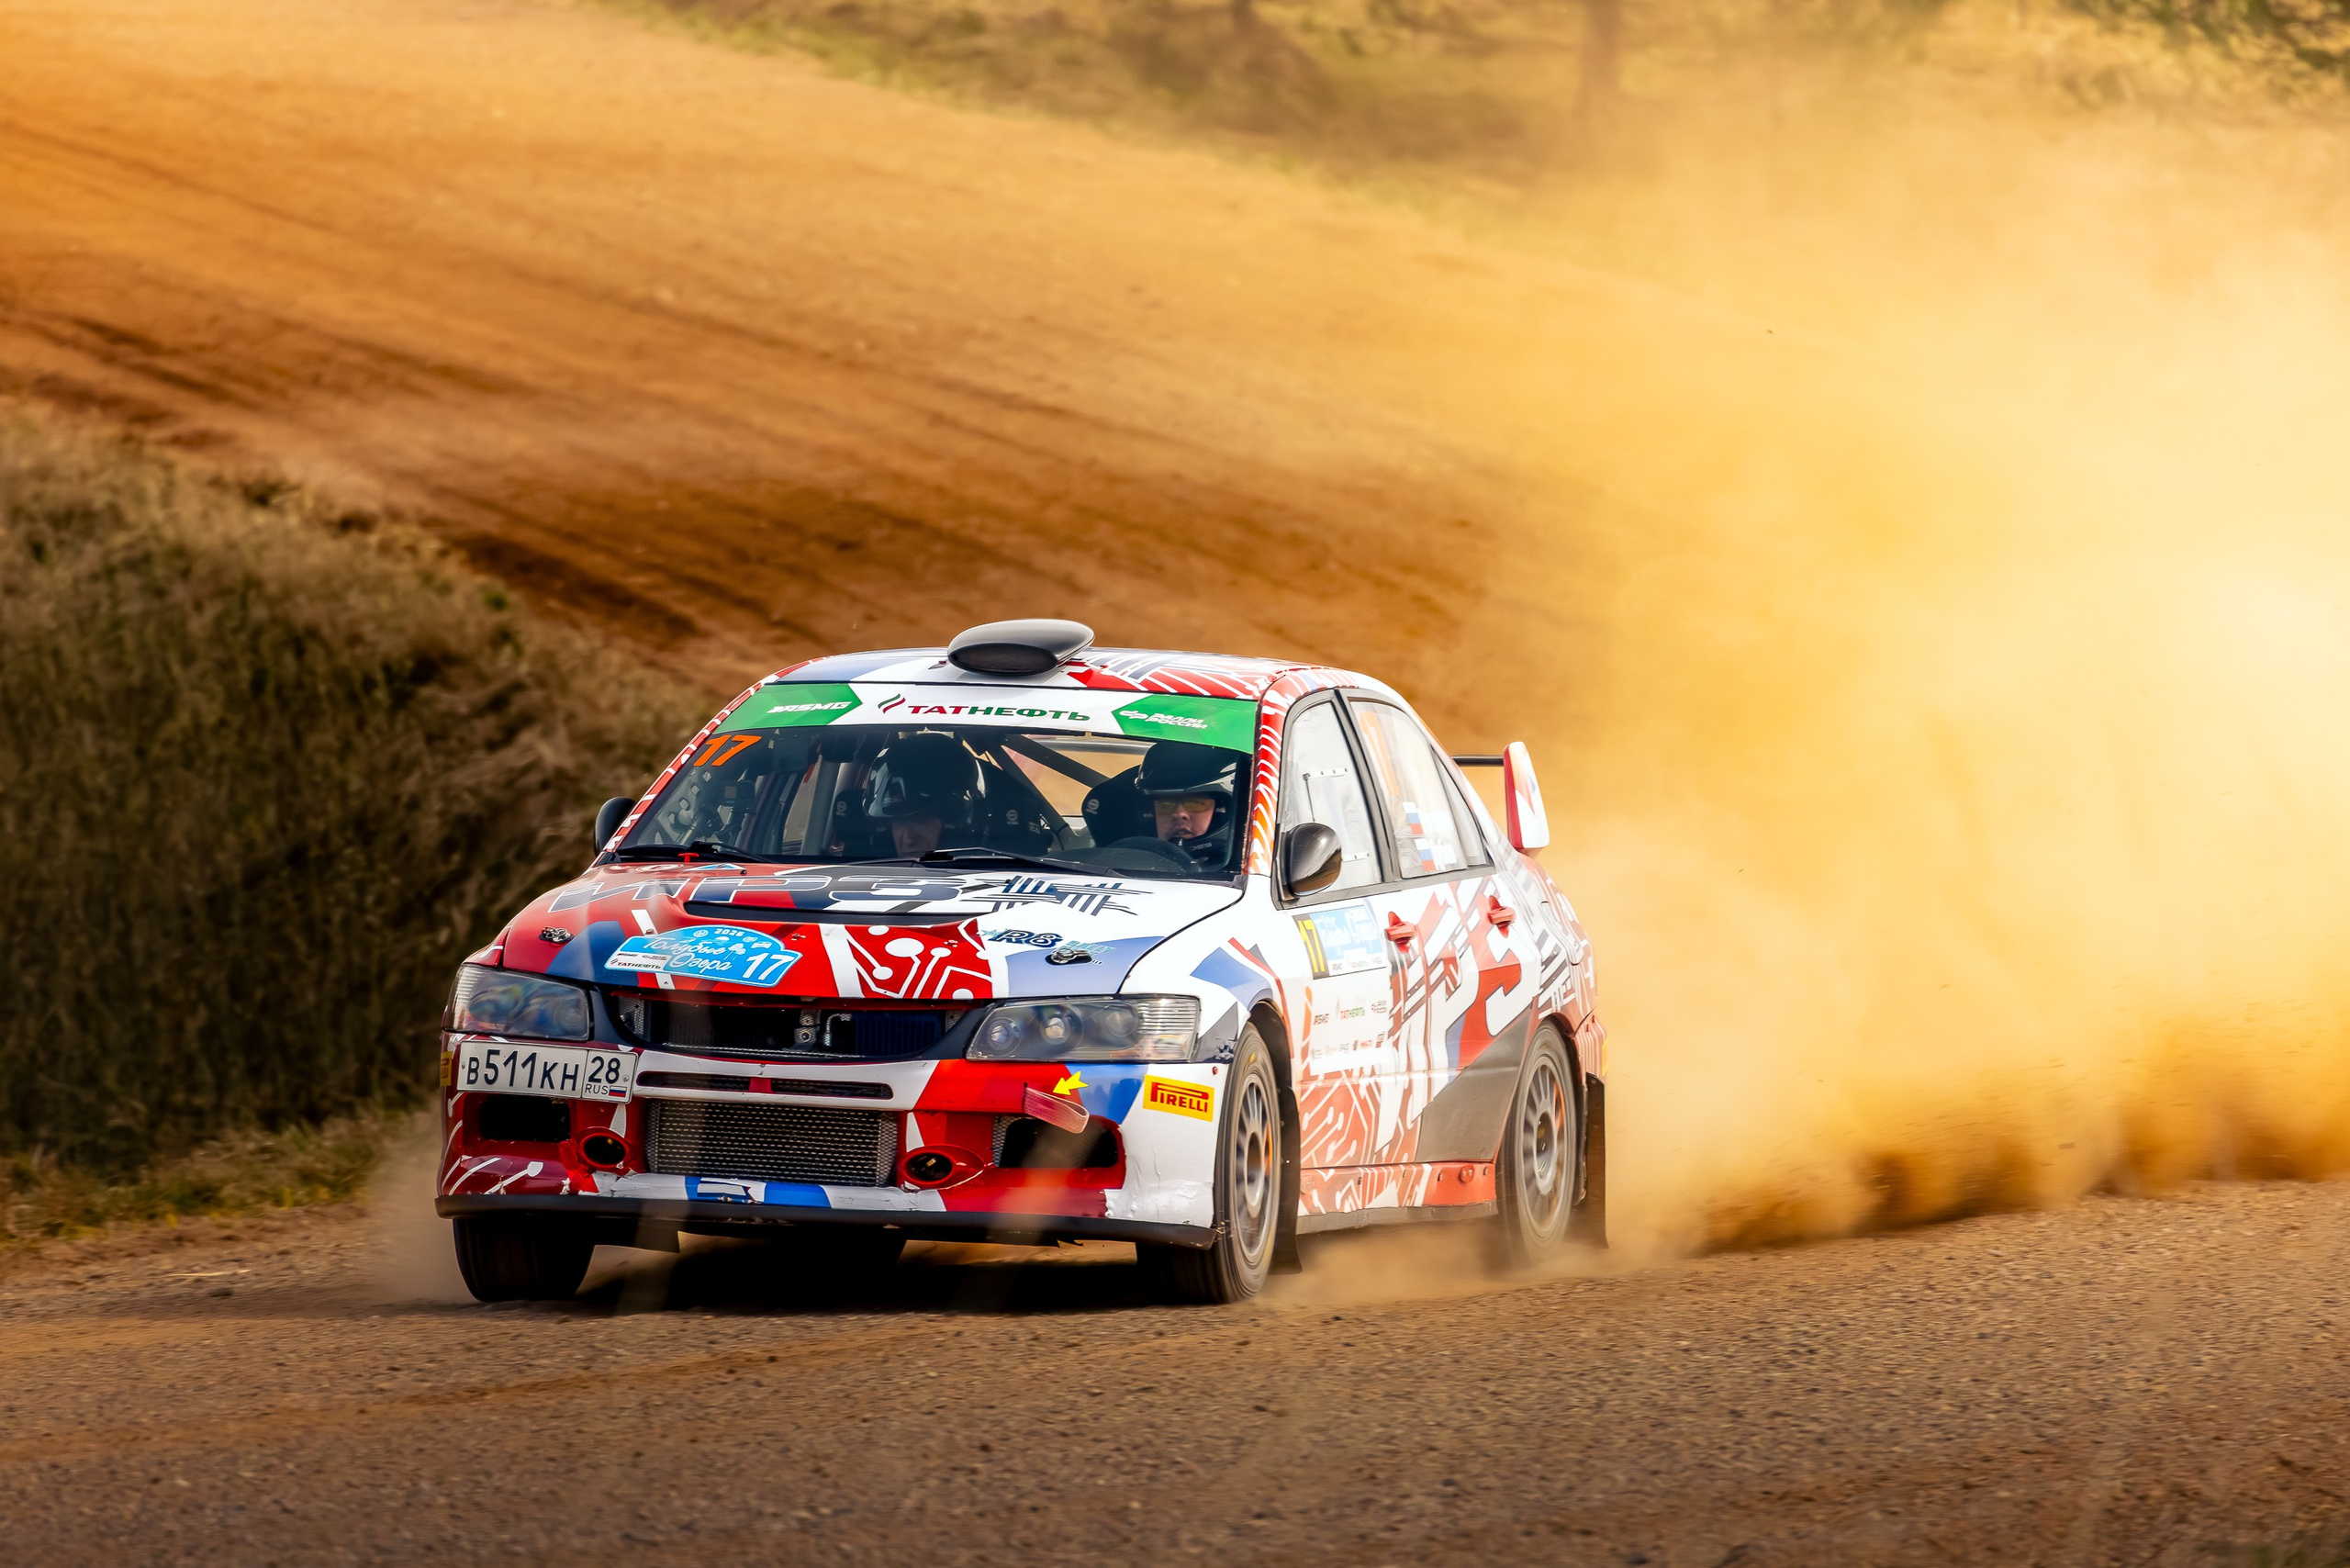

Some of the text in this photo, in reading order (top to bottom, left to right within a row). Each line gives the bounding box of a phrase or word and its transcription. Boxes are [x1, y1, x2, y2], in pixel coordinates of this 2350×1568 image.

[908, 705, 1091, 722] ТАТНЕФТЬ
[693, 734, 763, 767] 17
[643, 936, 727, 957] Голубые
[988, 929, 1063, 948] R8
[1297, 919, 1326, 973] 17
[670, 952, 733, 973] Озера
[743, 953, 796, 980] 17
[588, 1056, 621, 1083] 28
[585, 1083, 610, 1095] RUS
[1150, 1081, 1209, 1113] PIRELLI
